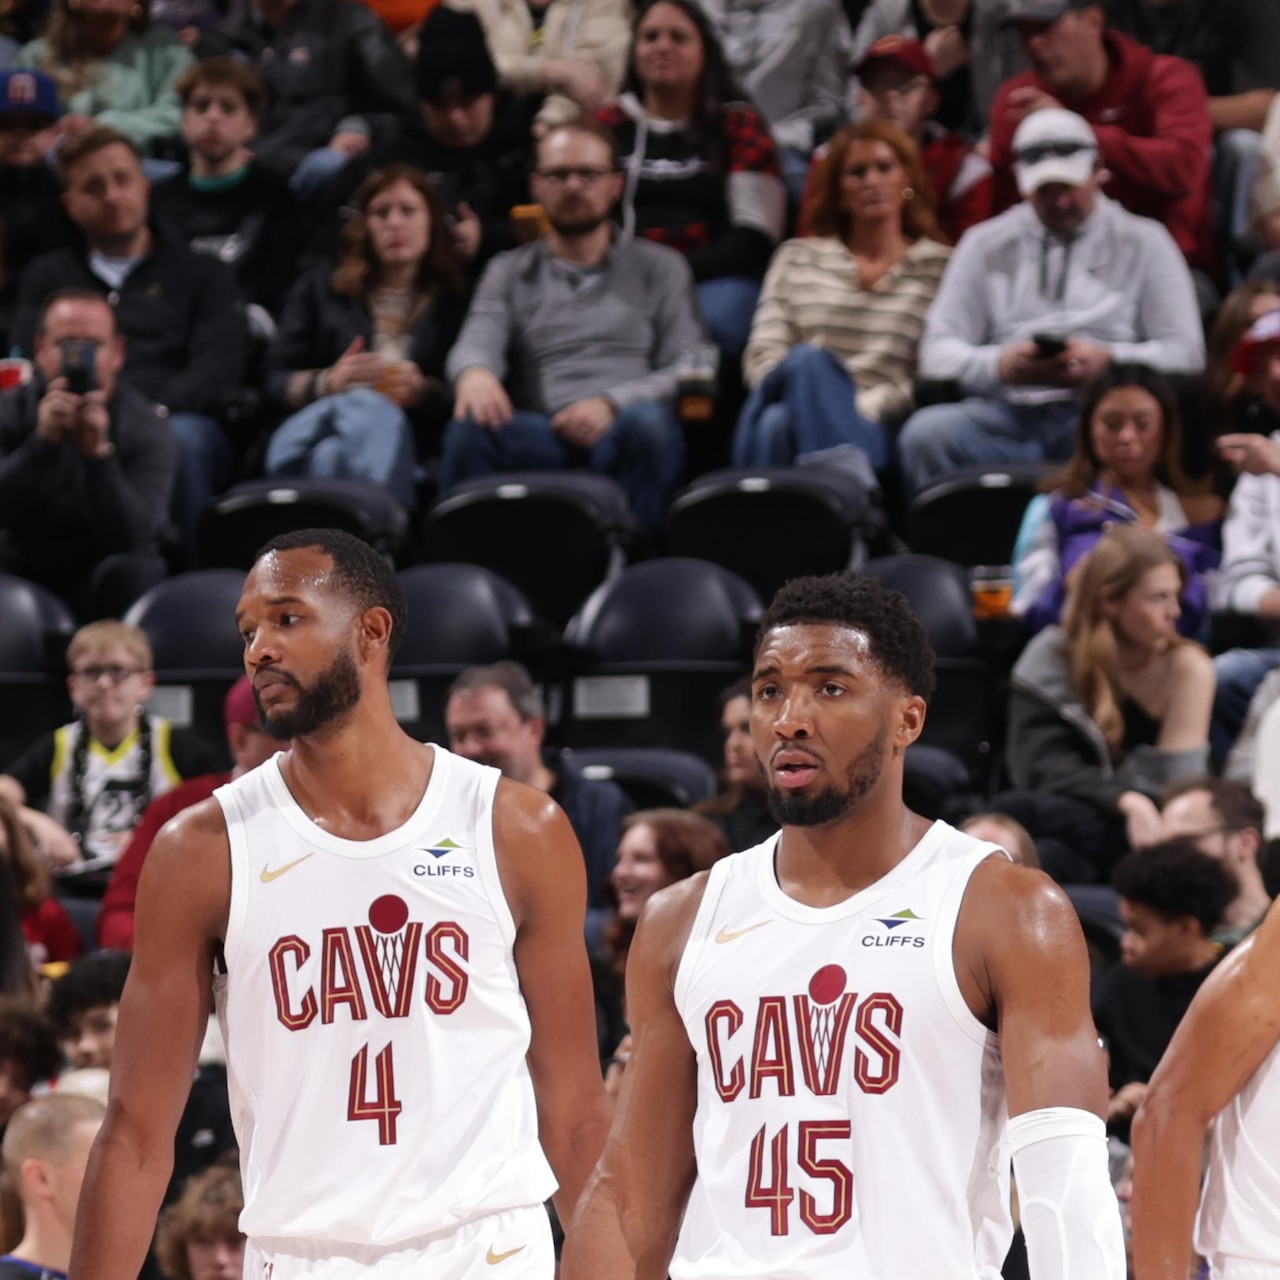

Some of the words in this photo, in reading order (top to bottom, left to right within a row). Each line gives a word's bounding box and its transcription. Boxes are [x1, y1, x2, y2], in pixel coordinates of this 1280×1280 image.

[413, 864, 474, 878] CLIFFS
[268, 921, 470, 1032] CAVS
[861, 935, 925, 948] CLIFFS
[347, 1040, 402, 1146] 4
[705, 992, 904, 1103] CAVS
[745, 1120, 854, 1236] 45
